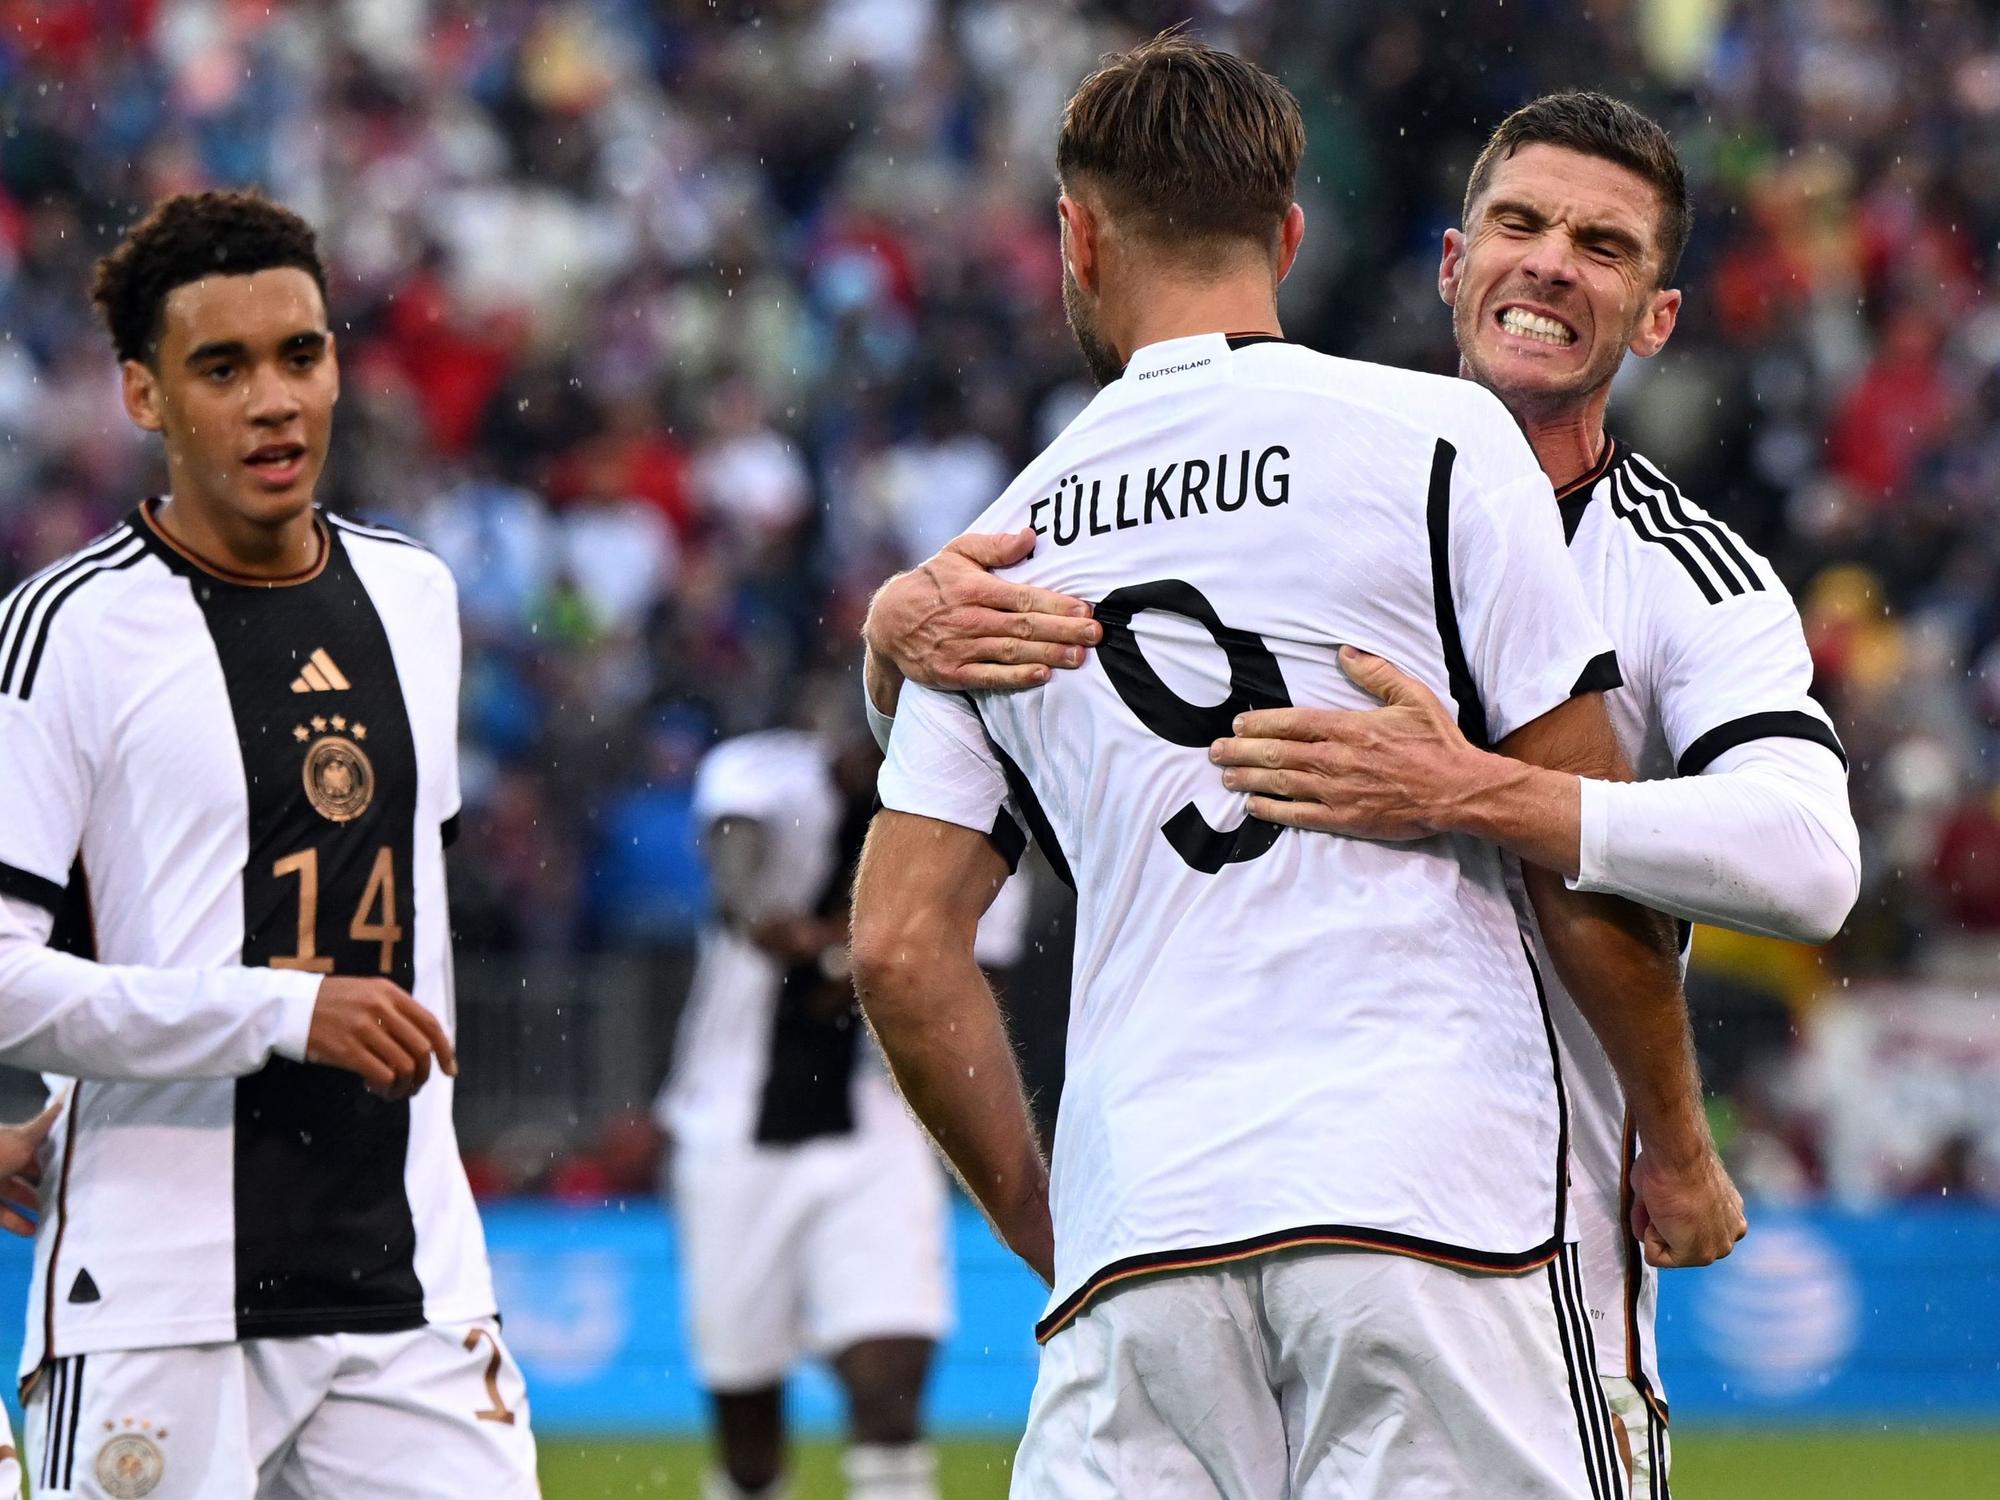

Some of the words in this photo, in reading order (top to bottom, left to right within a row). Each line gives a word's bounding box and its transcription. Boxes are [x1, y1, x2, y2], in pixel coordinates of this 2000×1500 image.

[1138, 358, 1212, 381] DEUTSCHLAND
[1026, 445, 1291, 561] FÜLLKRUG
[1091, 578, 1296, 876] 9
[268, 846, 403, 974] 14
